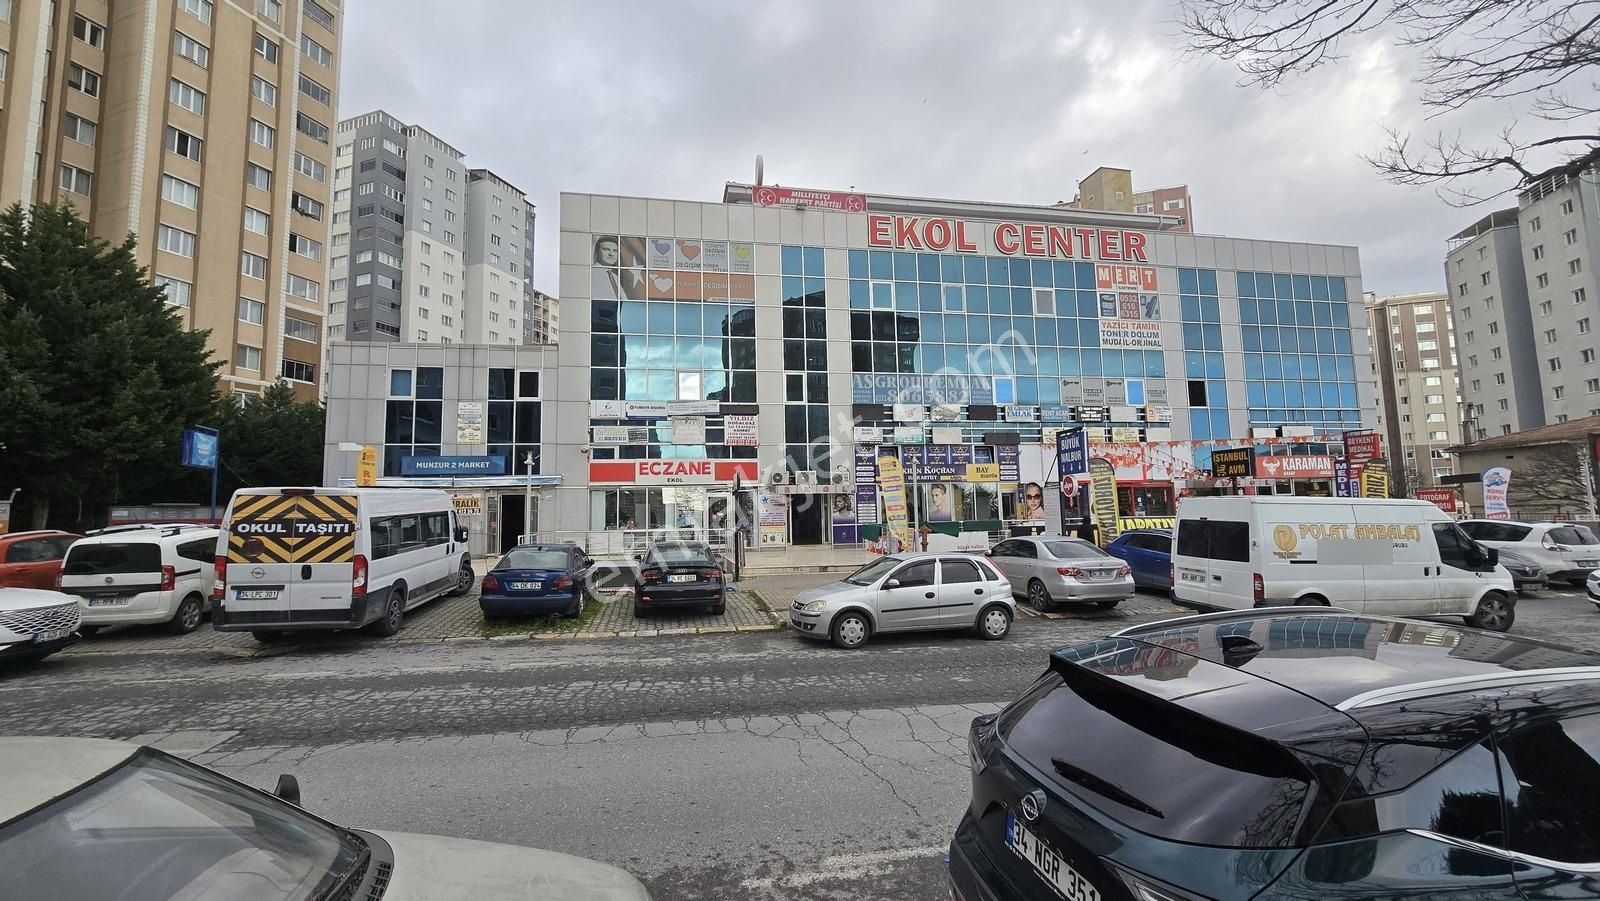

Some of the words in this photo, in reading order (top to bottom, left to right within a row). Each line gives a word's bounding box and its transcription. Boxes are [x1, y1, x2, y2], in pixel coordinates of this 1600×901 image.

[868, 213, 978, 253] EKOL
[995, 221, 1148, 262] CENTER
[1098, 267, 1153, 284] MERT
[1060, 436, 1081, 451] BÜYÜK
[1347, 437, 1375, 445] BEYKENT
[1348, 444, 1375, 453] MEDİKAL
[1213, 451, 1249, 463] İSTANBUL
[1282, 457, 1331, 471] KARAMAN
[416, 461, 450, 469] MUNZUR
[451, 461, 456, 469] 2
[457, 461, 490, 469] MARKET
[639, 461, 712, 476] ECZANE
[1228, 466, 1246, 475] AVM
[1420, 493, 1451, 501] FOTOĞRAF
[237, 522, 287, 534] OKUL
[296, 522, 350, 536] TAŞITI
[1298, 523, 1350, 540] POLAT
[1353, 524, 1422, 543] AMBALAJ
[1013, 820, 1028, 854] 34
[1034, 839, 1060, 884] NGR
